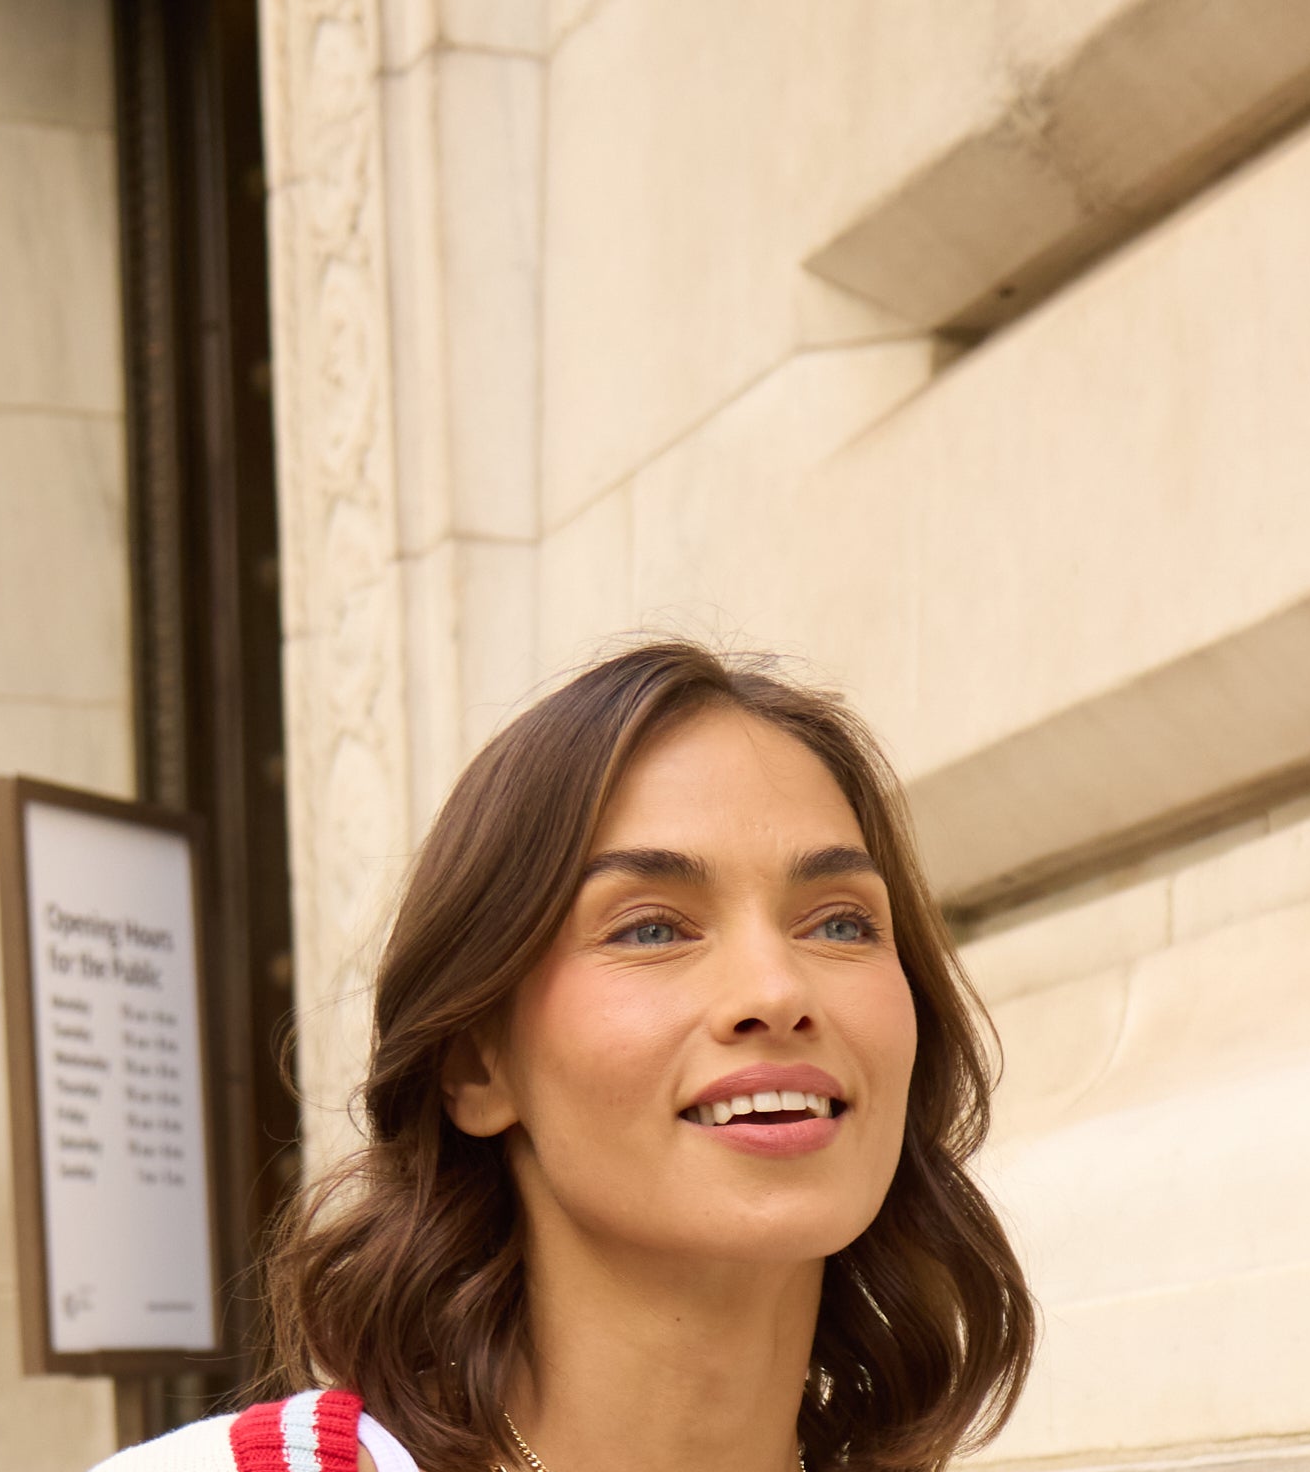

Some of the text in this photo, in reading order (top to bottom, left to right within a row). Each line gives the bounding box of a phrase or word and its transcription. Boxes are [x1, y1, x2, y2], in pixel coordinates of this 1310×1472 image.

[45, 902, 174, 952] Opening Hours
[48, 942, 162, 989] for the Public
